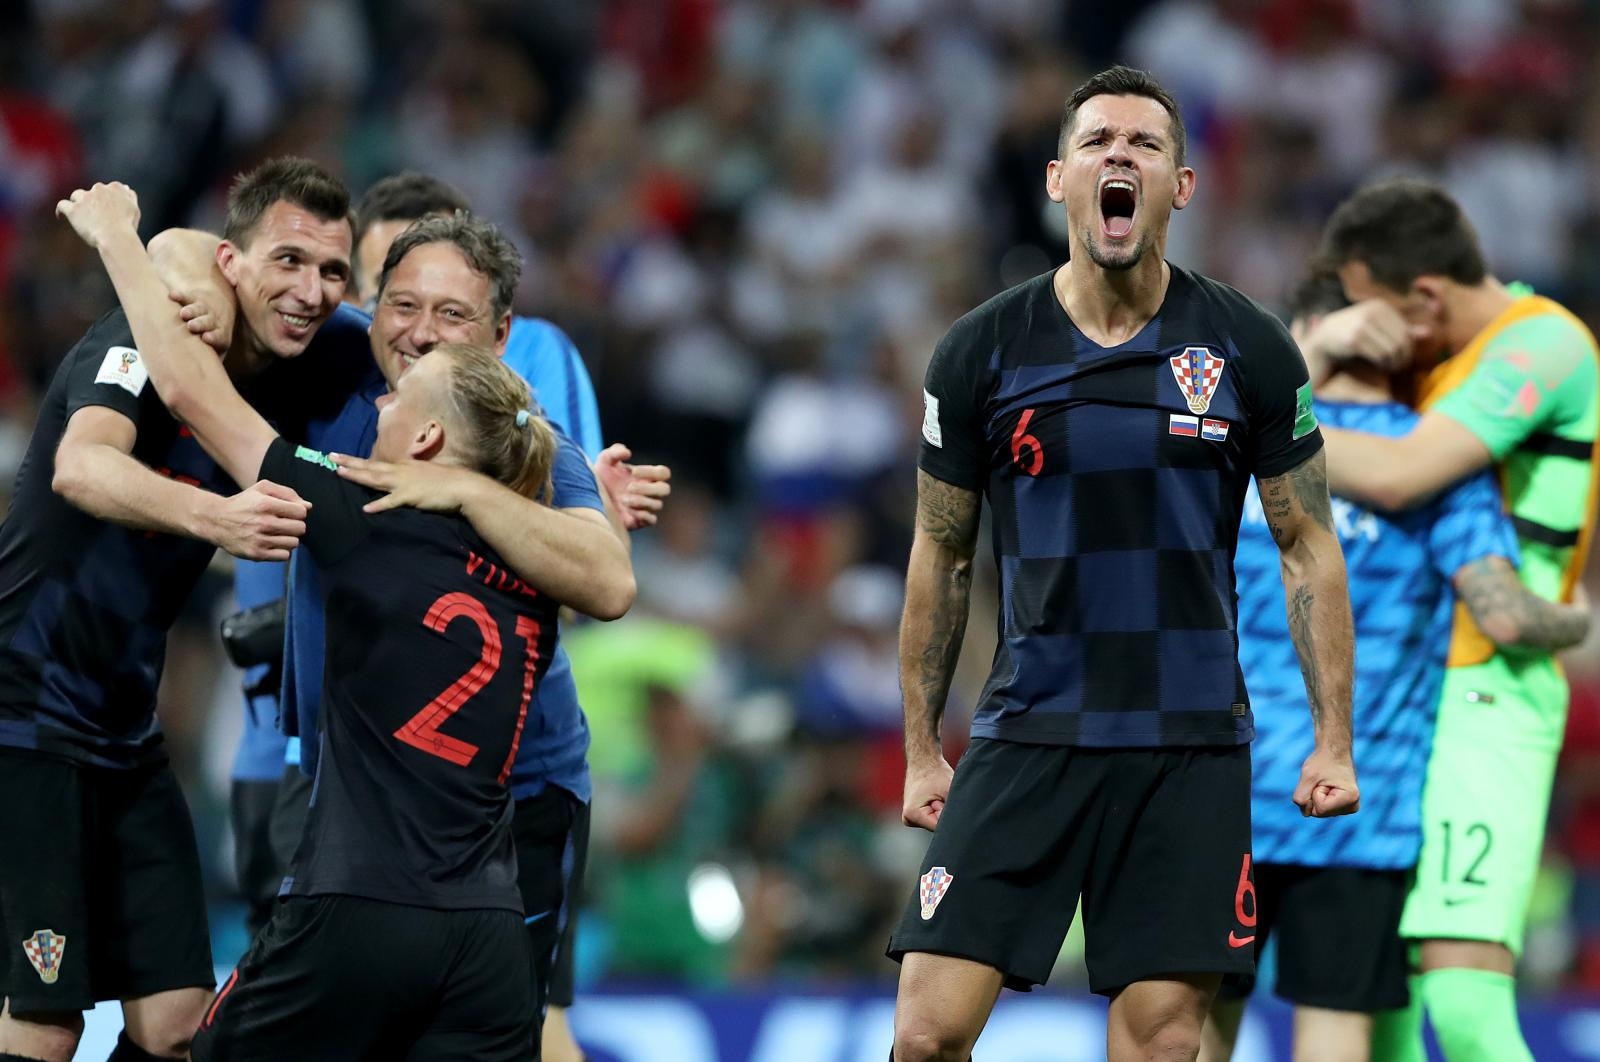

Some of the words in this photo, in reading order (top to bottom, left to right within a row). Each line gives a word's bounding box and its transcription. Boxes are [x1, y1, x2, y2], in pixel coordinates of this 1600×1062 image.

[1011, 409, 1044, 477] 6
[392, 591, 541, 785] 21
[1440, 821, 1493, 887] 12
[1235, 853, 1256, 927] 6
